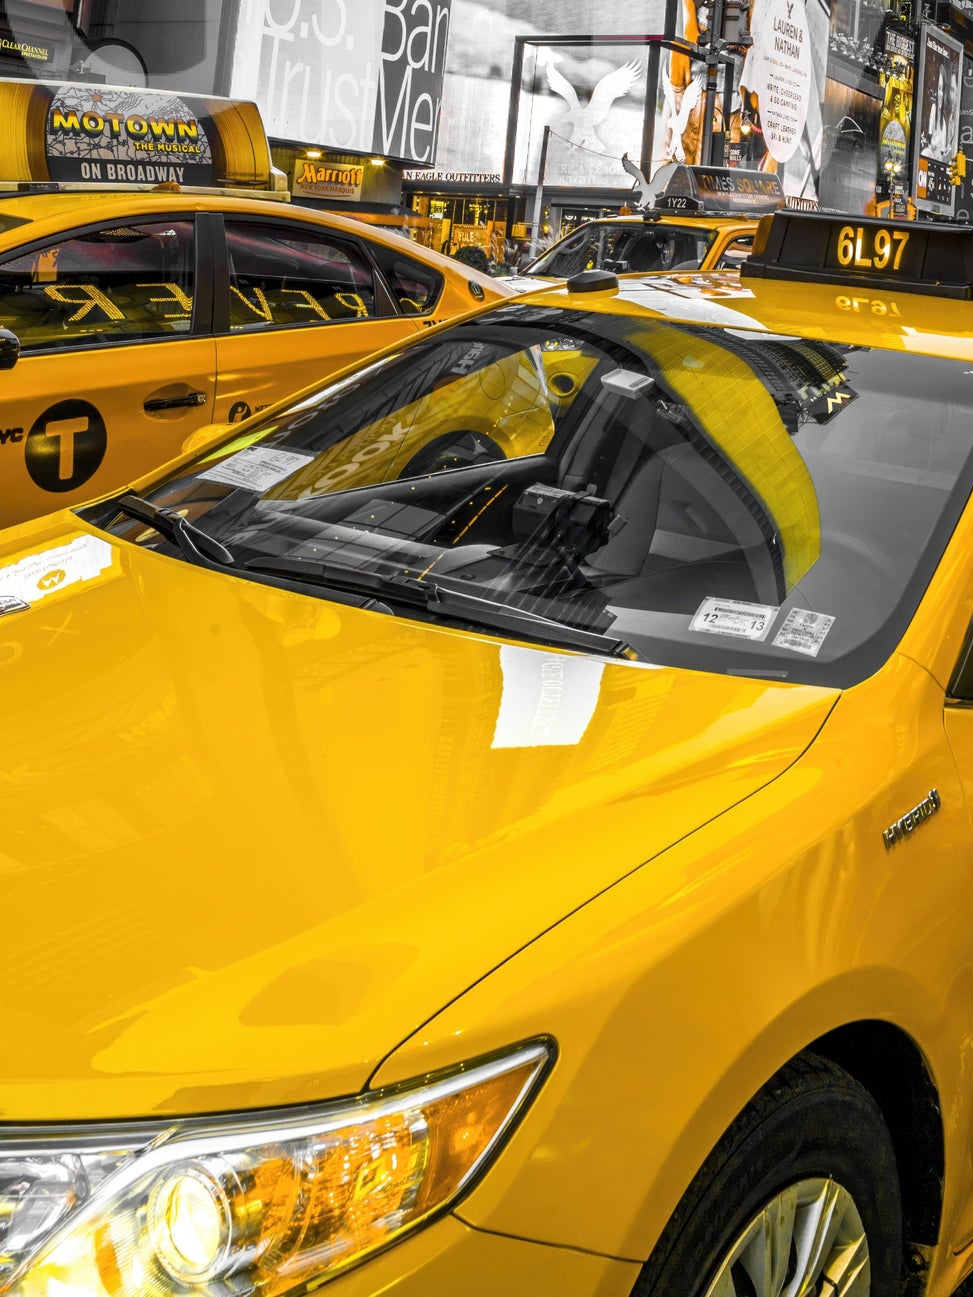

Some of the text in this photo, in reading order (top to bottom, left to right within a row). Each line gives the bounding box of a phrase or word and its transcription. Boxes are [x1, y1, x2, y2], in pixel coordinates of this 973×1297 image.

[774, 16, 804, 43] LAUREN &
[774, 36, 800, 61] NATHAN
[262, 25, 377, 154] Trust
[50, 108, 200, 144] MOTOWN
[135, 141, 202, 154] THE MUSICAL
[80, 161, 186, 185] ON BROADWAY
[297, 163, 363, 187] Marriott
[416, 171, 444, 182] EAGLE
[446, 172, 501, 183] OUTFITTERS
[702, 174, 782, 196] TIMES SQUARE
[314, 184, 328, 192] YORK
[667, 198, 687, 209] 1Y22
[837, 226, 910, 270] 6L97
[703, 612, 719, 624] 12
[750, 620, 765, 632] 13
[883, 787, 942, 853] HYBRID
